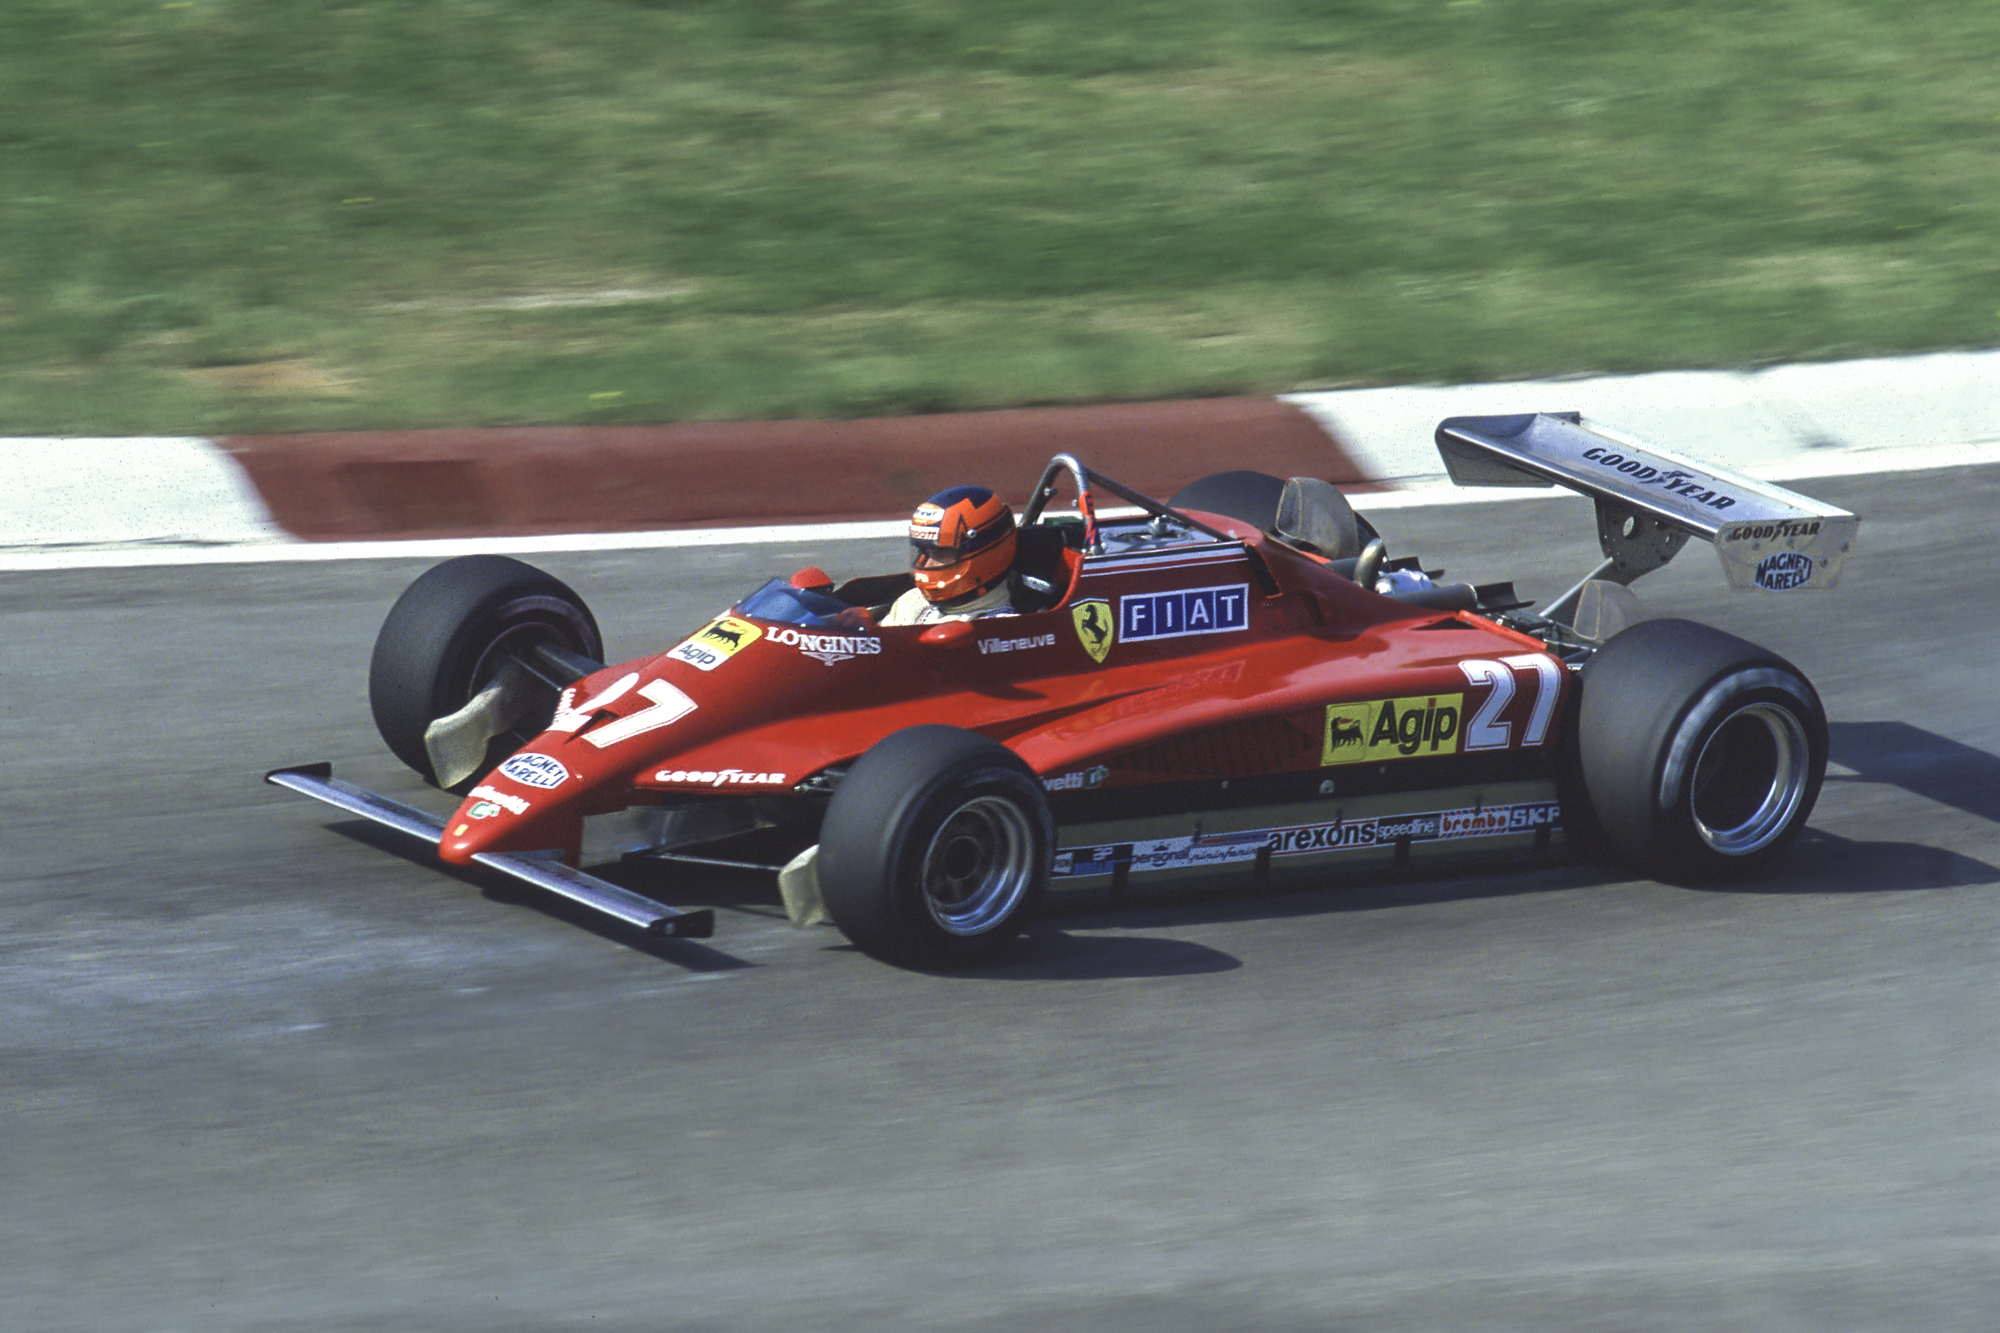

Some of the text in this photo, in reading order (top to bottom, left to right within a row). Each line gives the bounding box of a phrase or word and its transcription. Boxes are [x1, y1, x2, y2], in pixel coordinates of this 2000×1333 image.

[1131, 594, 1240, 631] FIAT
[765, 627, 882, 654] LONGINES
[977, 633, 1056, 655] Villeneuve
[678, 643, 717, 665] Agip
[1458, 653, 1562, 752] 27
[1368, 697, 1458, 755] Agip
[1038, 771, 1084, 791] vetti
[1442, 810, 1507, 832] brembo
[1510, 806, 1559, 828] SKF
[1267, 821, 1376, 851] arexons
